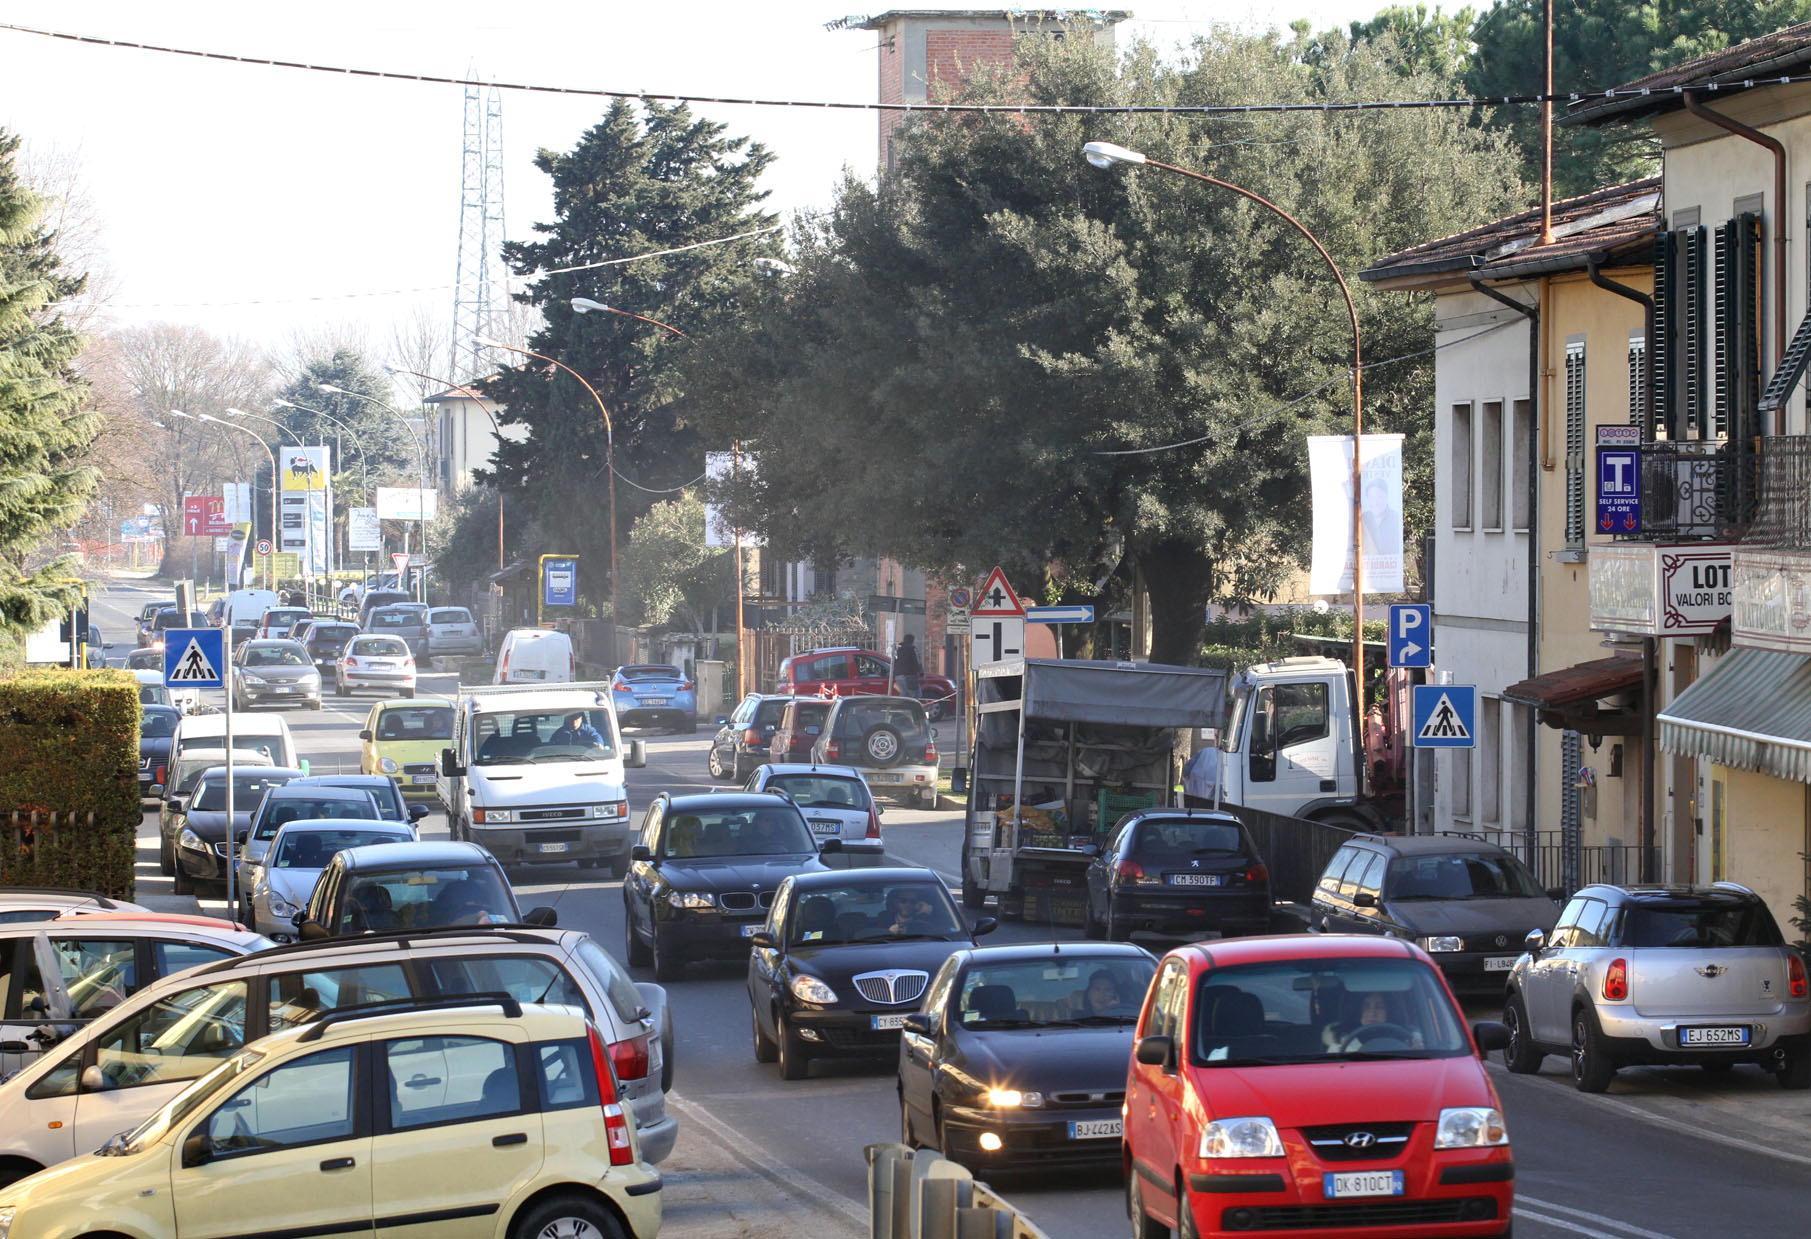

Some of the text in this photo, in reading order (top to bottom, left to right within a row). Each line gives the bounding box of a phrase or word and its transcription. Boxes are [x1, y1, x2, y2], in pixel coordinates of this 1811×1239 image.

[1606, 457, 1631, 491] T
[260, 544, 269, 552] 50
[1676, 592, 1713, 607] VALORI
[1400, 609, 1422, 638] P
[1706, 1029, 1741, 1041] 652MS
